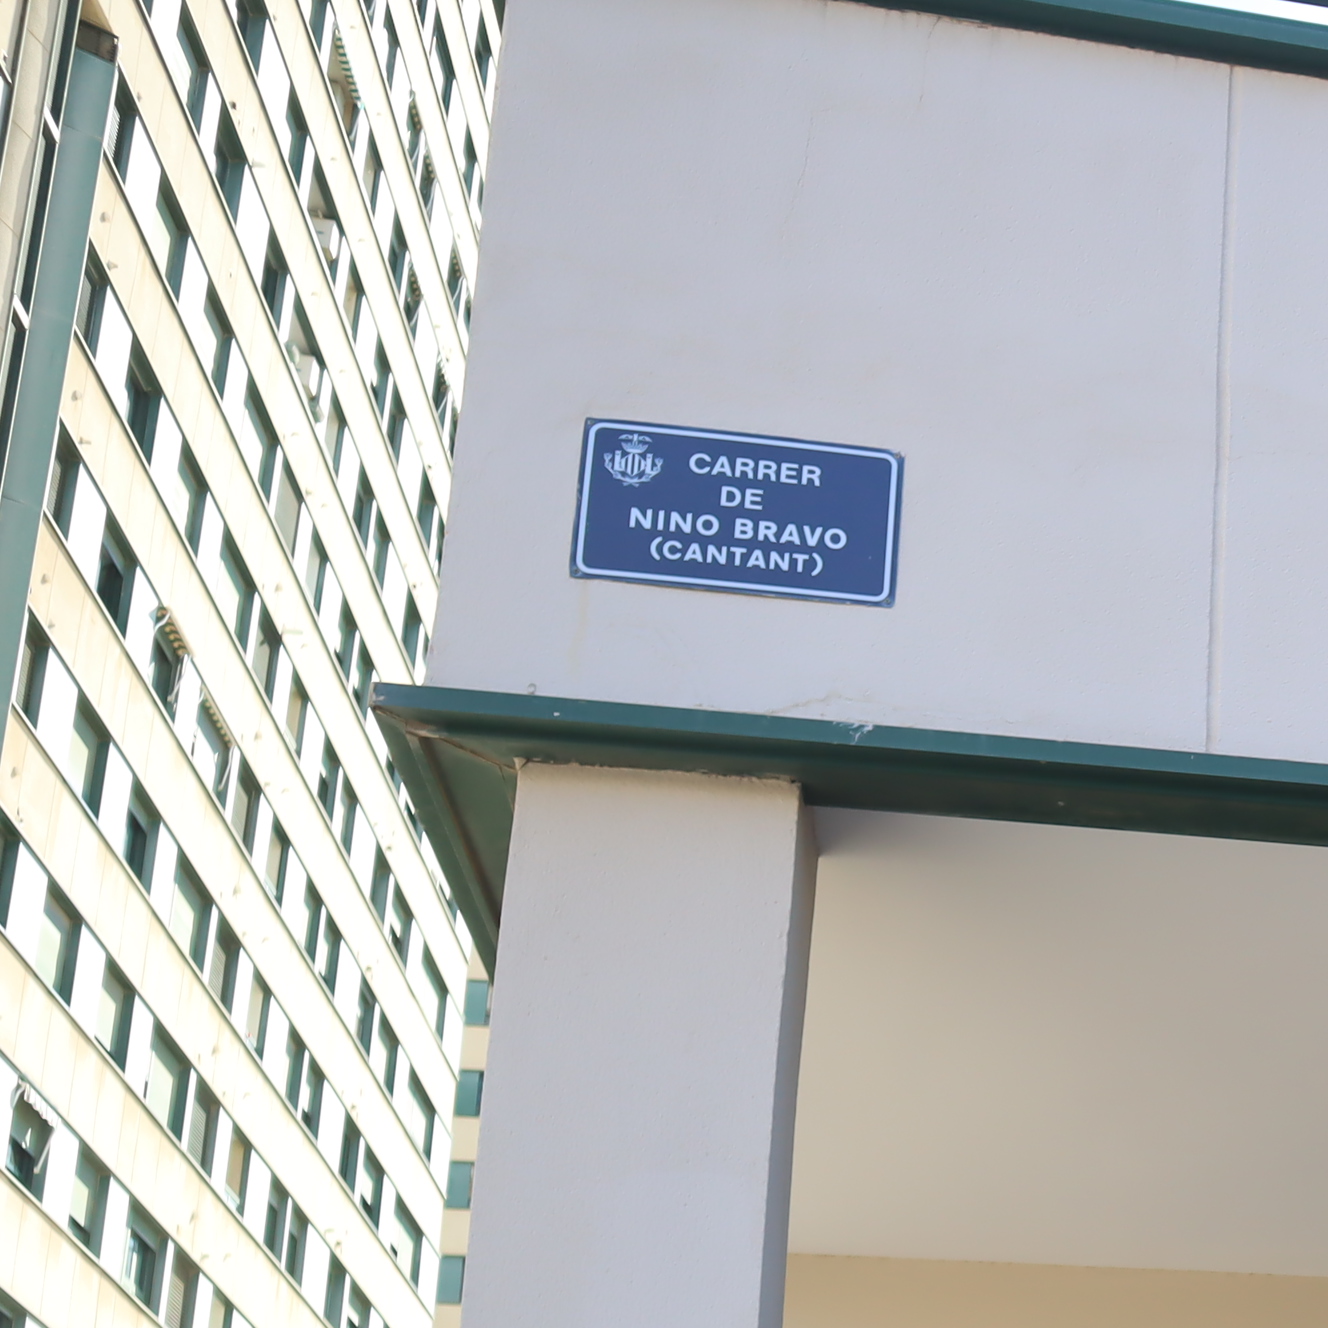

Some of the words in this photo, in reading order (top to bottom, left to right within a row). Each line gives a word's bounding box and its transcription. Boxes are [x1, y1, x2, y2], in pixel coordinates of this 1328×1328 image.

[688, 452, 823, 488] CARRER
[719, 485, 764, 511] DE
[628, 506, 720, 537] NINO
[733, 516, 848, 550] BRAVO
[649, 536, 824, 577] (CANTANT)
